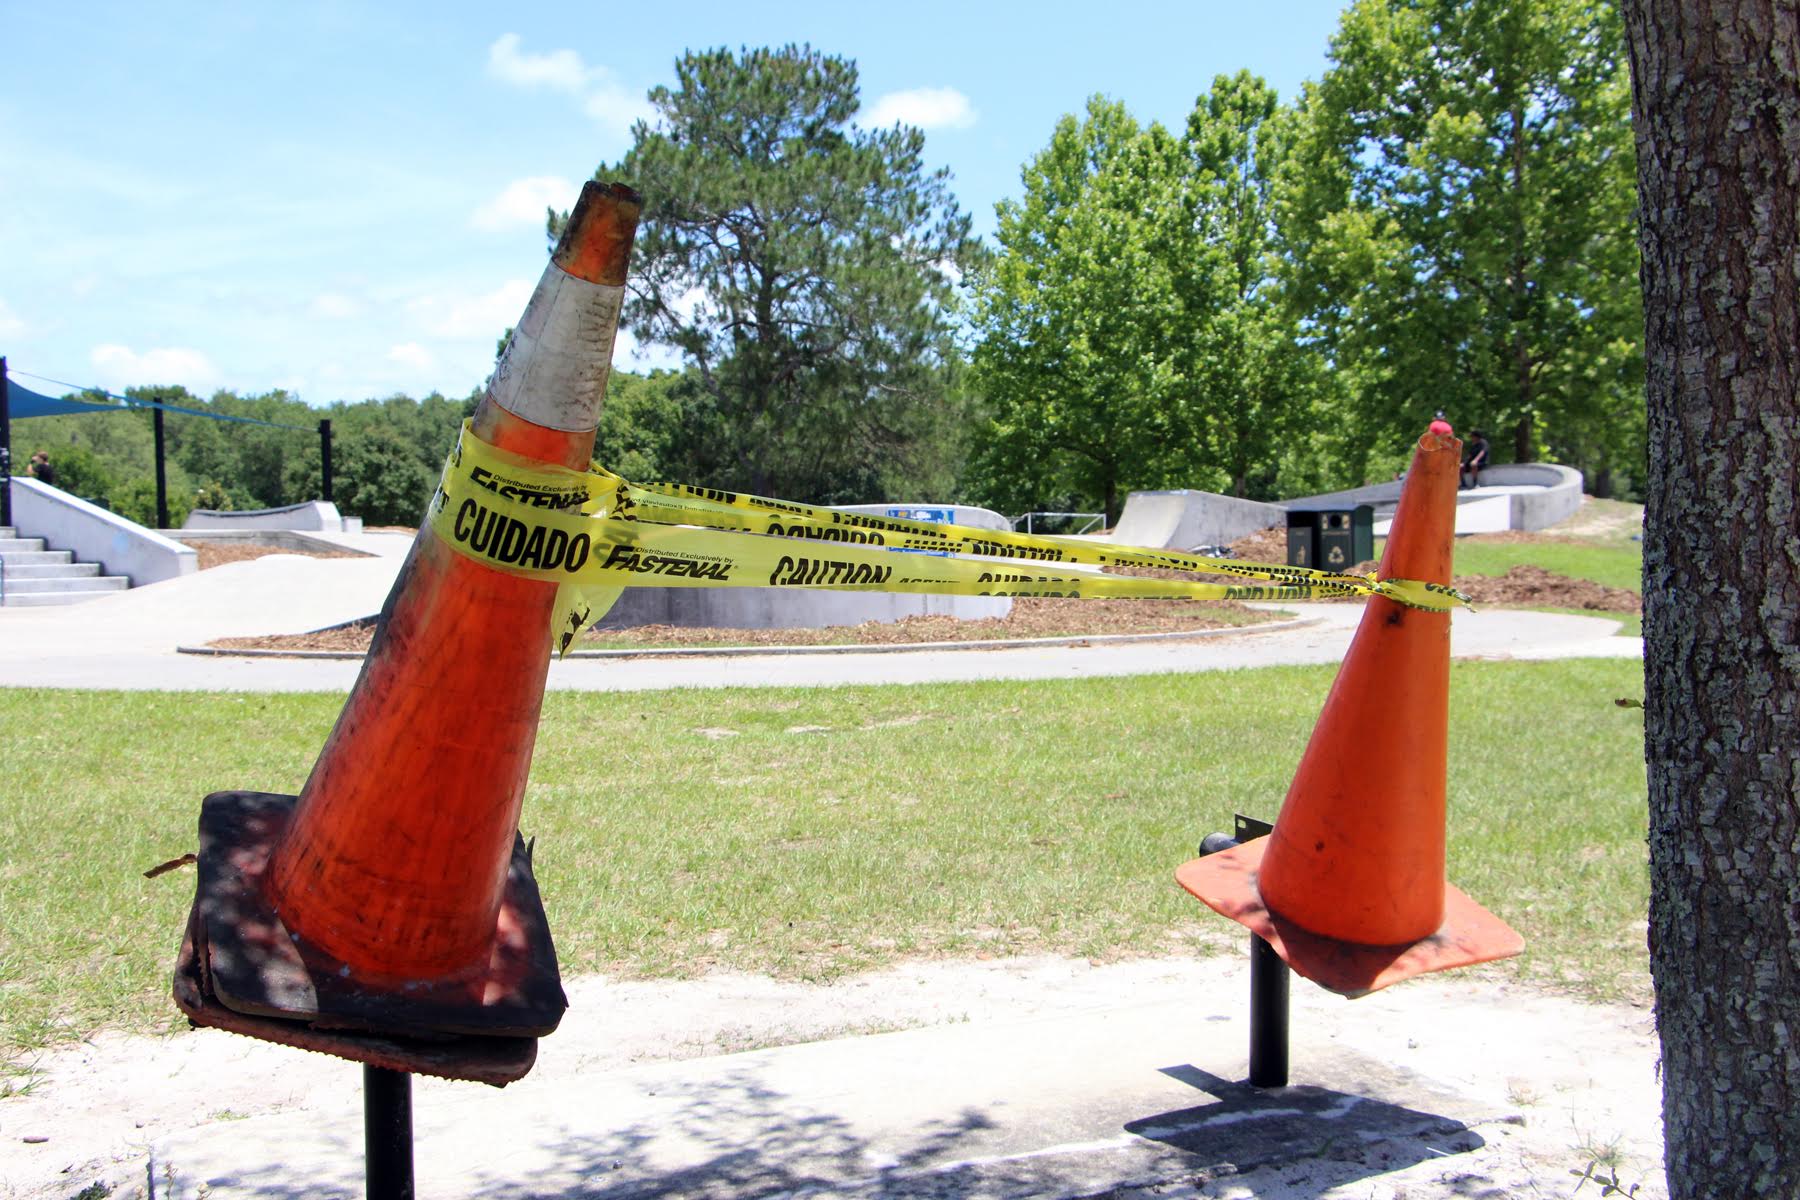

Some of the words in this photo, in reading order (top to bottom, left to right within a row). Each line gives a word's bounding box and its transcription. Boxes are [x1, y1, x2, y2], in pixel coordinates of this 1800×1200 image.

[493, 474, 541, 491] Distributed
[454, 498, 591, 573] CUIDADO
[600, 544, 732, 581] FASTENAL
[635, 547, 678, 558] Distributed
[679, 552, 722, 563] Exclusively
[724, 556, 734, 564] by
[769, 555, 893, 586] CAUTION
